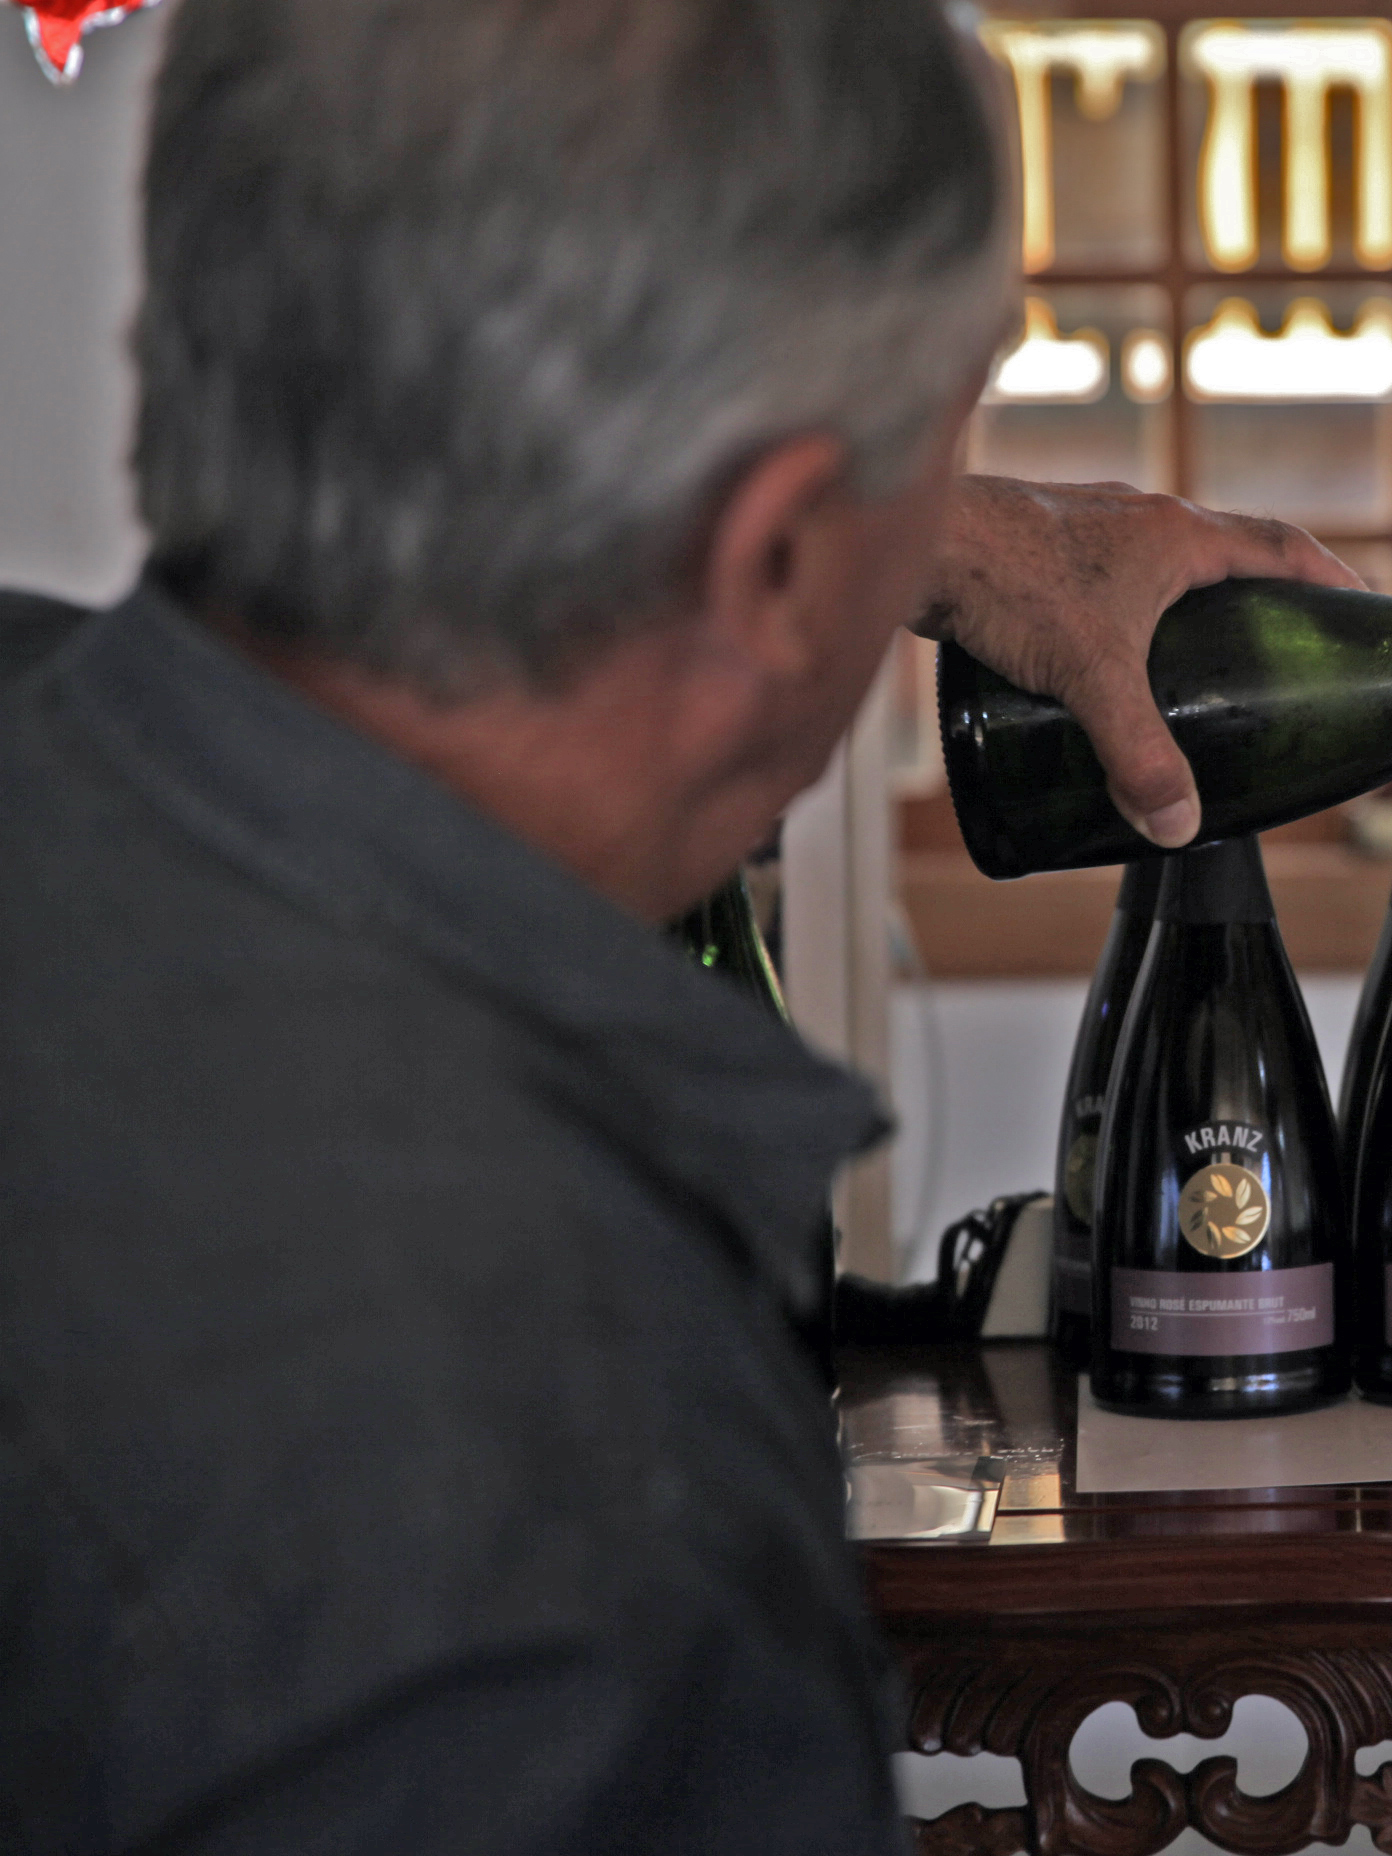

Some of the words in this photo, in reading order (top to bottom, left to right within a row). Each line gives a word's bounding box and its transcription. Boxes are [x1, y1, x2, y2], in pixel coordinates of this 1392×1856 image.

[1184, 1125, 1263, 1154] KRANZ
[1189, 1299, 1254, 1311] ESPUMANTE
[1130, 1315, 1159, 1331] 2012
